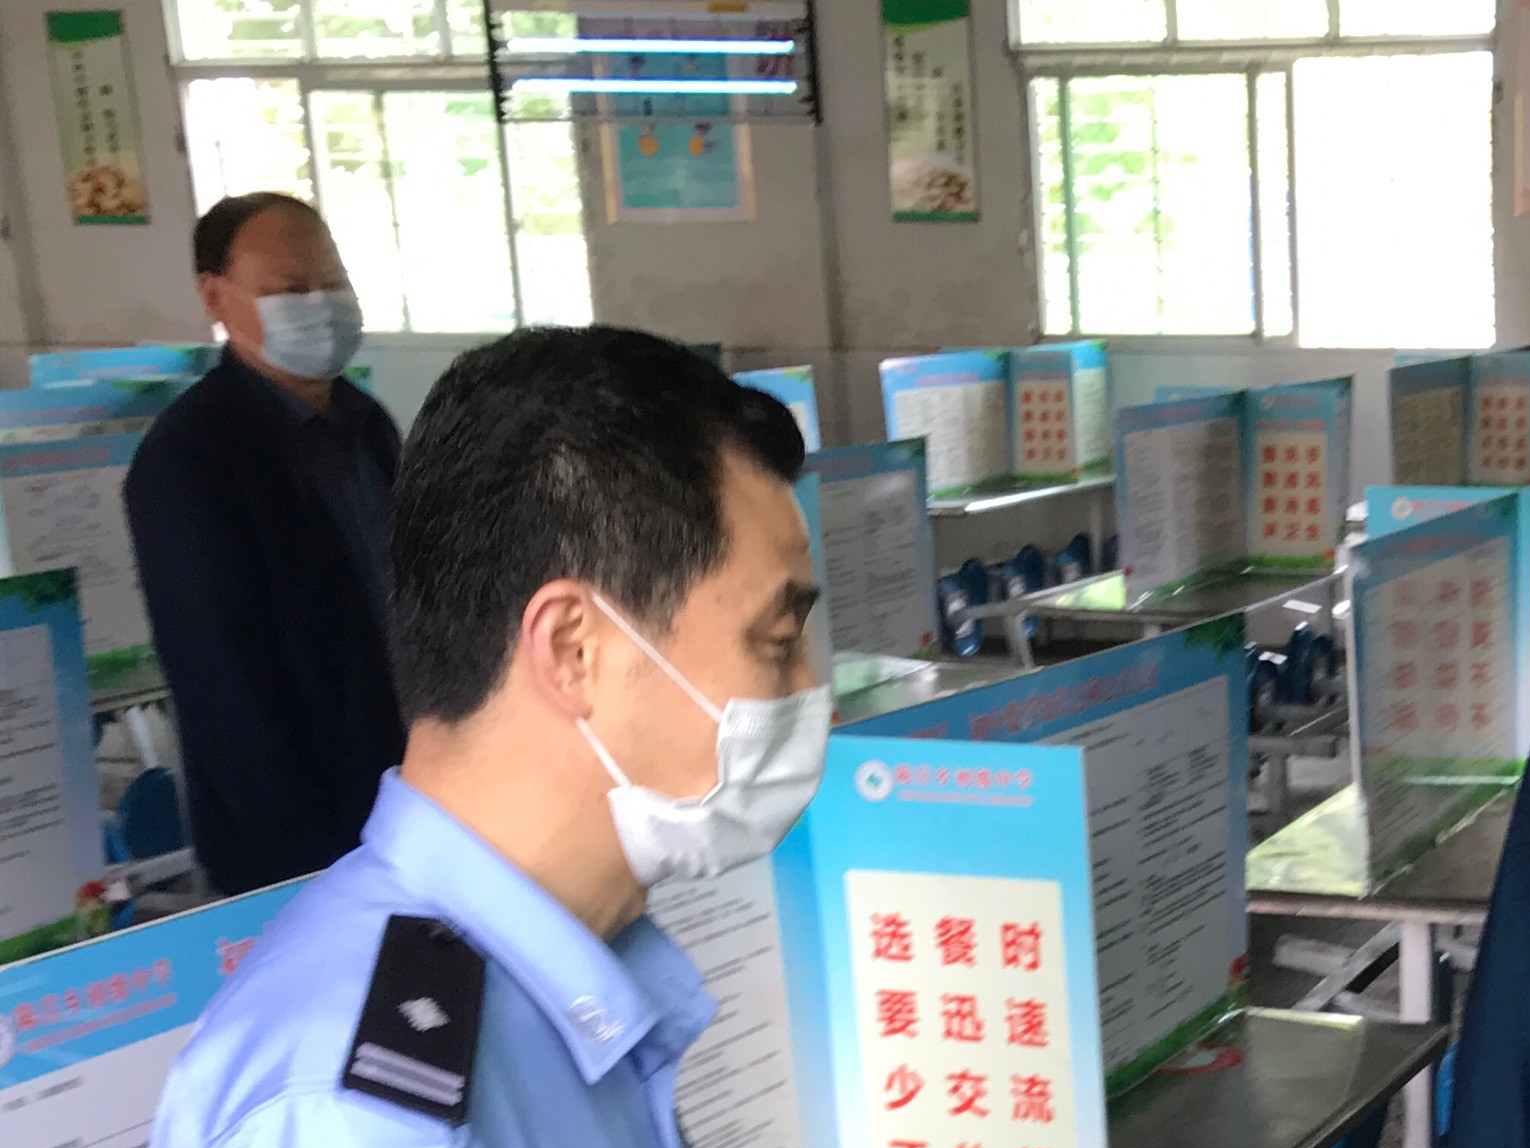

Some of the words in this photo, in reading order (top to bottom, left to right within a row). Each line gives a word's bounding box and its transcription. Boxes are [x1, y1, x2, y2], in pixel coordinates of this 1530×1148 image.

[870, 911, 1043, 971] 选餐时
[875, 988, 1049, 1049] 要迅速
[883, 1063, 1055, 1123] 少交流
